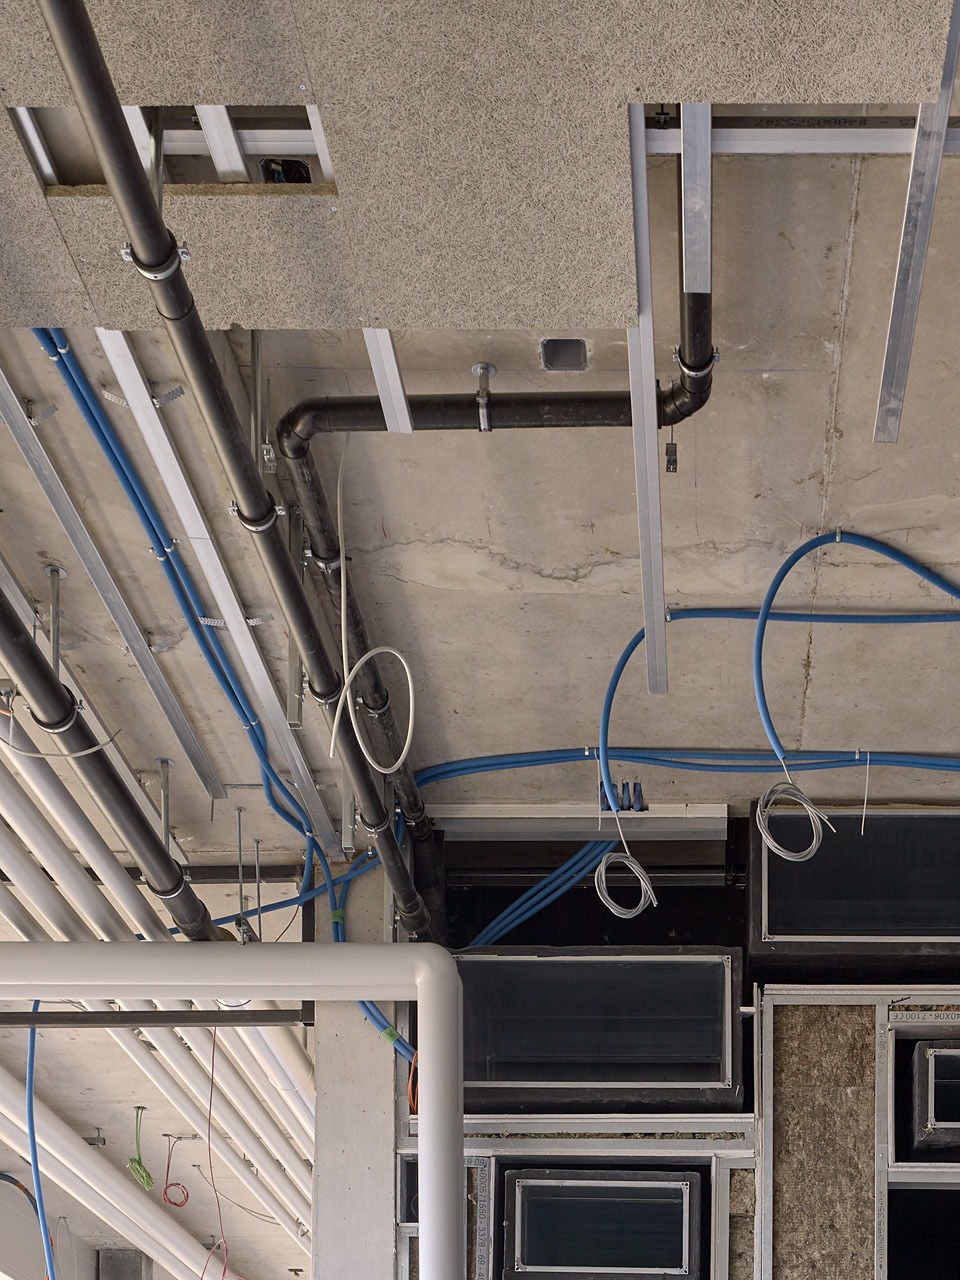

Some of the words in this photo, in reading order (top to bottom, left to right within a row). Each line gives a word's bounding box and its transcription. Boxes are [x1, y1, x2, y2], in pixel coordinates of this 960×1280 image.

[905, 1012, 927, 1020] Z100
[478, 1226, 487, 1248] 3378
[478, 1254, 486, 1265] 69
